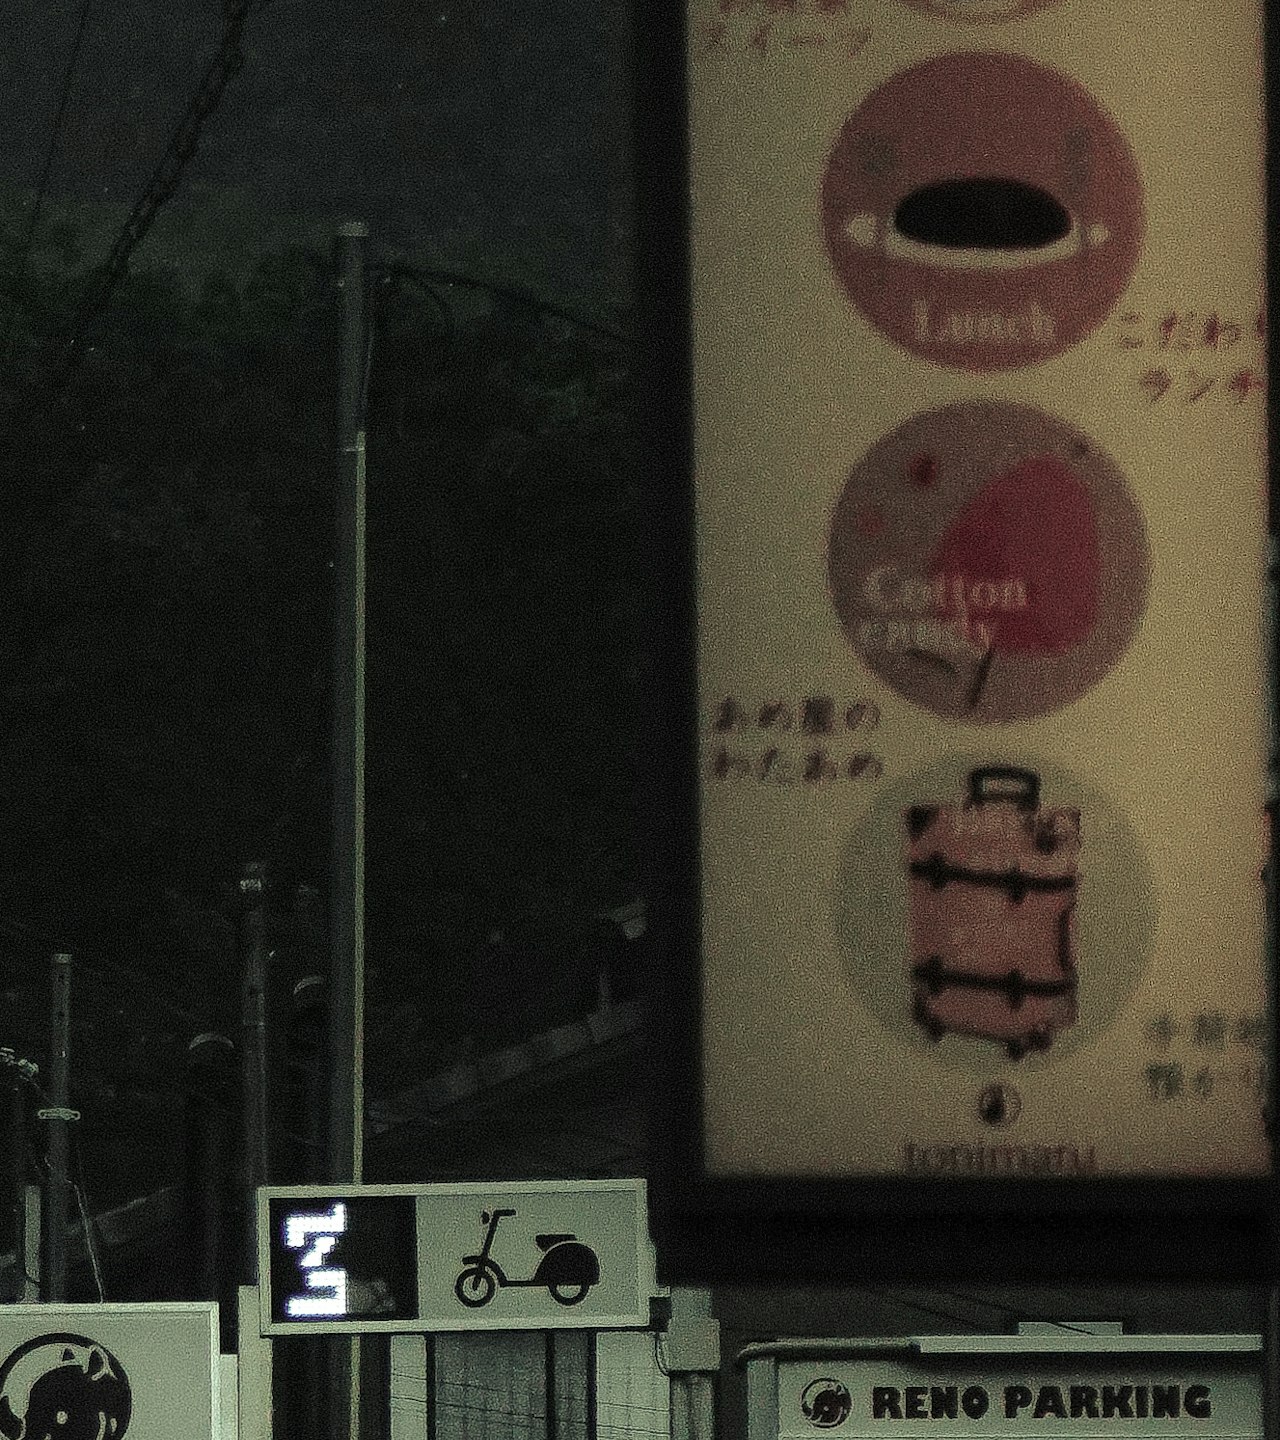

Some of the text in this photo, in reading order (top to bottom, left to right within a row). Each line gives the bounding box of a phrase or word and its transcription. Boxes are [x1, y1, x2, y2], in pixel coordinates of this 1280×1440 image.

[912, 299, 1058, 344] Lunch
[862, 566, 1030, 612] Cotton
[871, 1384, 1212, 1420] RENO PARKING
